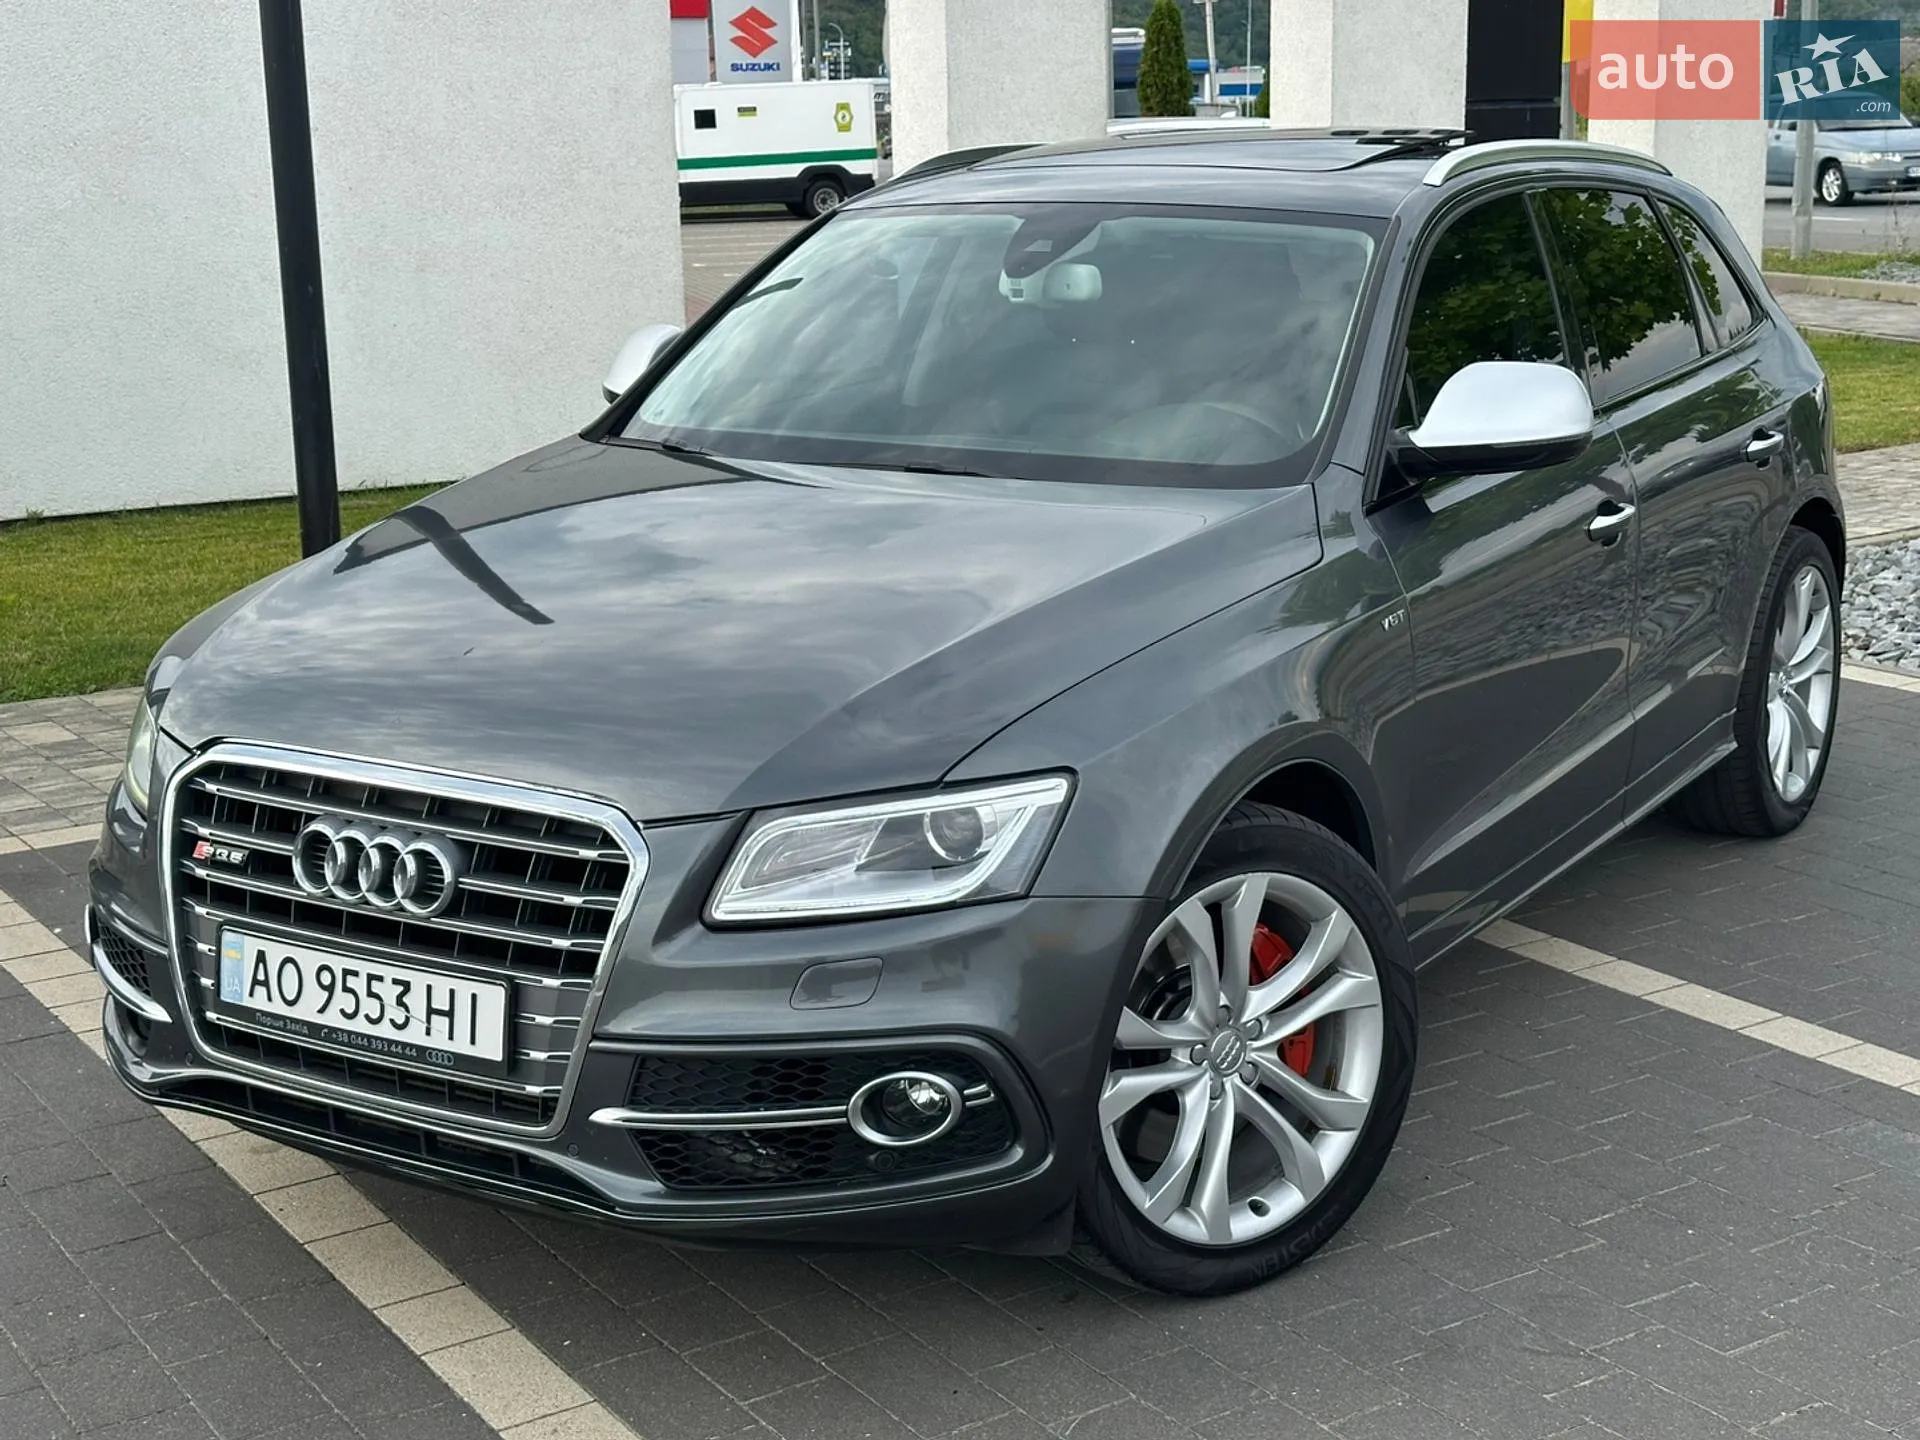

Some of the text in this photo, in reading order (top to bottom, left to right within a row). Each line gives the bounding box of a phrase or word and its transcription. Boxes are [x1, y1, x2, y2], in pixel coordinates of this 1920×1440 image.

[730, 62, 780, 72] SUZUKI
[224, 977, 241, 994] UA
[248, 949, 478, 1046] AO 9553 HI
